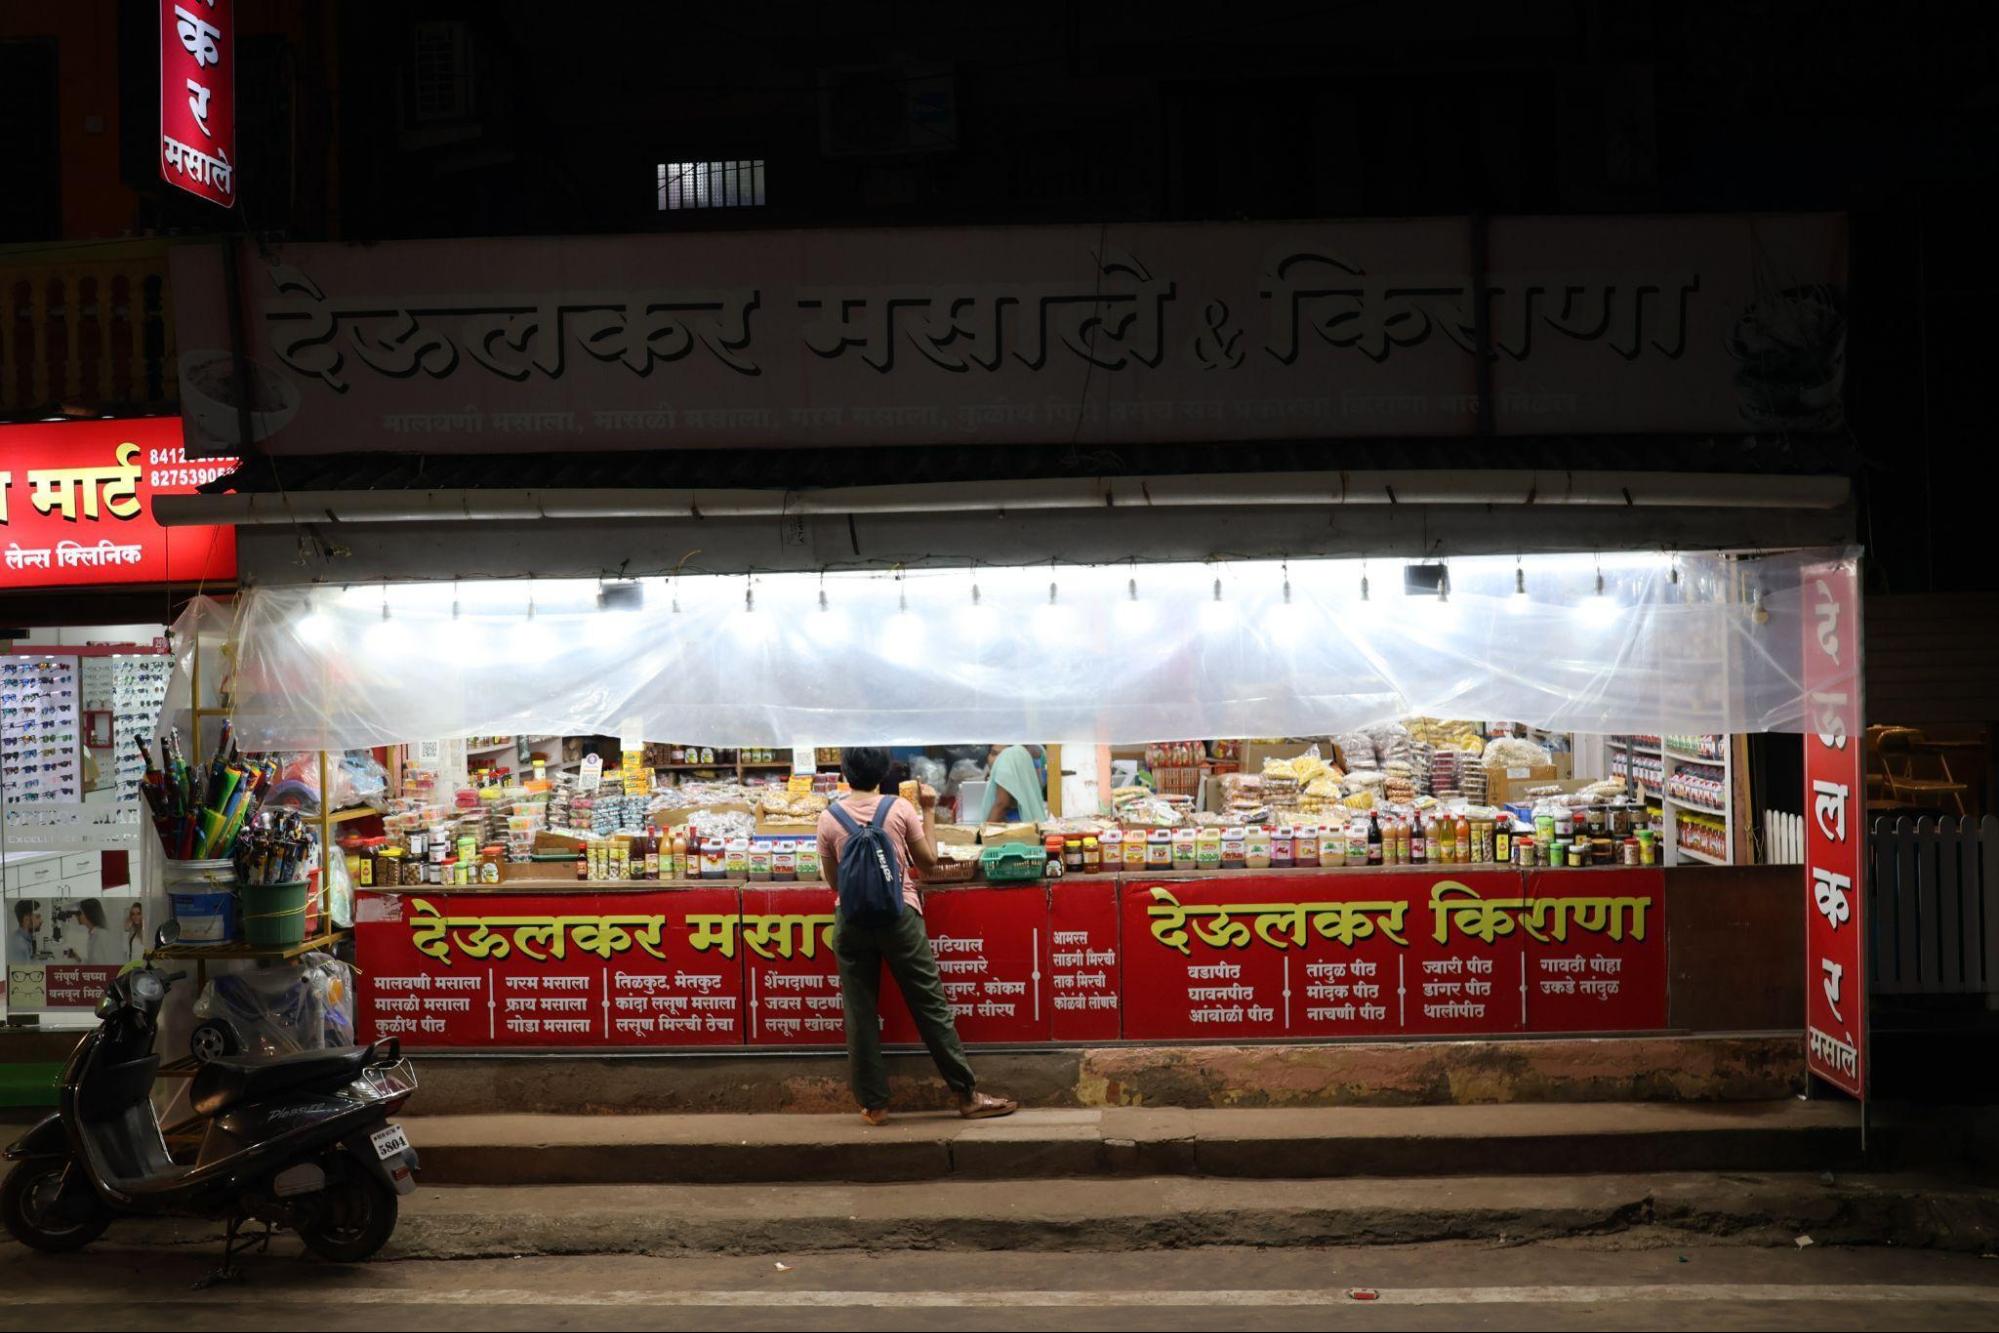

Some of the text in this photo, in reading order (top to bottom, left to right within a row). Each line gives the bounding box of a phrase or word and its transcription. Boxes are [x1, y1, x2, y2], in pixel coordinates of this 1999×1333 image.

[163, 135, 233, 194] मसाले
[266, 248, 1699, 393] देऊलकर मसाले & किराणा
[28, 442, 142, 523] मार्ट
[150, 468, 236, 487] 82753905
[5, 540, 142, 569] लेन्स क्लिनिक
[1147, 879, 1652, 955] देऊलकर किराणा
[410, 898, 666, 965] देऊलकर
[1086, 947, 1116, 967] मिरची
[1423, 955, 1493, 975] ज्वारी पीठ
[1539, 953, 1622, 975] गावठी पोहा
[1077, 970, 1106, 988] मिरची
[1187, 960, 1241, 979] वडापीठ
[1306, 958, 1377, 984] तांदुळ पीठ
[374, 973, 481, 990] मालवणी मसाला
[506, 976, 589, 990] गरम मसाला
[675, 970, 722, 993] मेतकुट
[764, 970, 824, 991] शेंगदाणा
[941, 977, 1026, 1001] जुगर, कोकम
[1306, 980, 1379, 1001] मोदक पीठ
[1423, 977, 1492, 997] डांगर पीठ
[1539, 975, 1620, 1000] उकडे तांदुळ
[375, 995, 470, 1011] मासळी मसाला
[506, 998, 587, 1012] फ्राय मसाला
[615, 993, 736, 1015] कांदा लसूण मसाला
[764, 996, 802, 1010] जवस
[1247, 1003, 1274, 1022] पीठ
[1307, 1002, 1386, 1021] नाचणी पीठ
[1423, 1000, 1486, 1019] थालीपीठ
[375, 1016, 446, 1037] कुळीथ पीठ
[507, 1015, 591, 1032] गोडा मसाला
[616, 1014, 734, 1037] लसूण मिरची ठेचा
[764, 1018, 801, 1037] लसूण
[1809, 1026, 1857, 1080] मसाले
[378, 1136, 408, 1156] 5804
